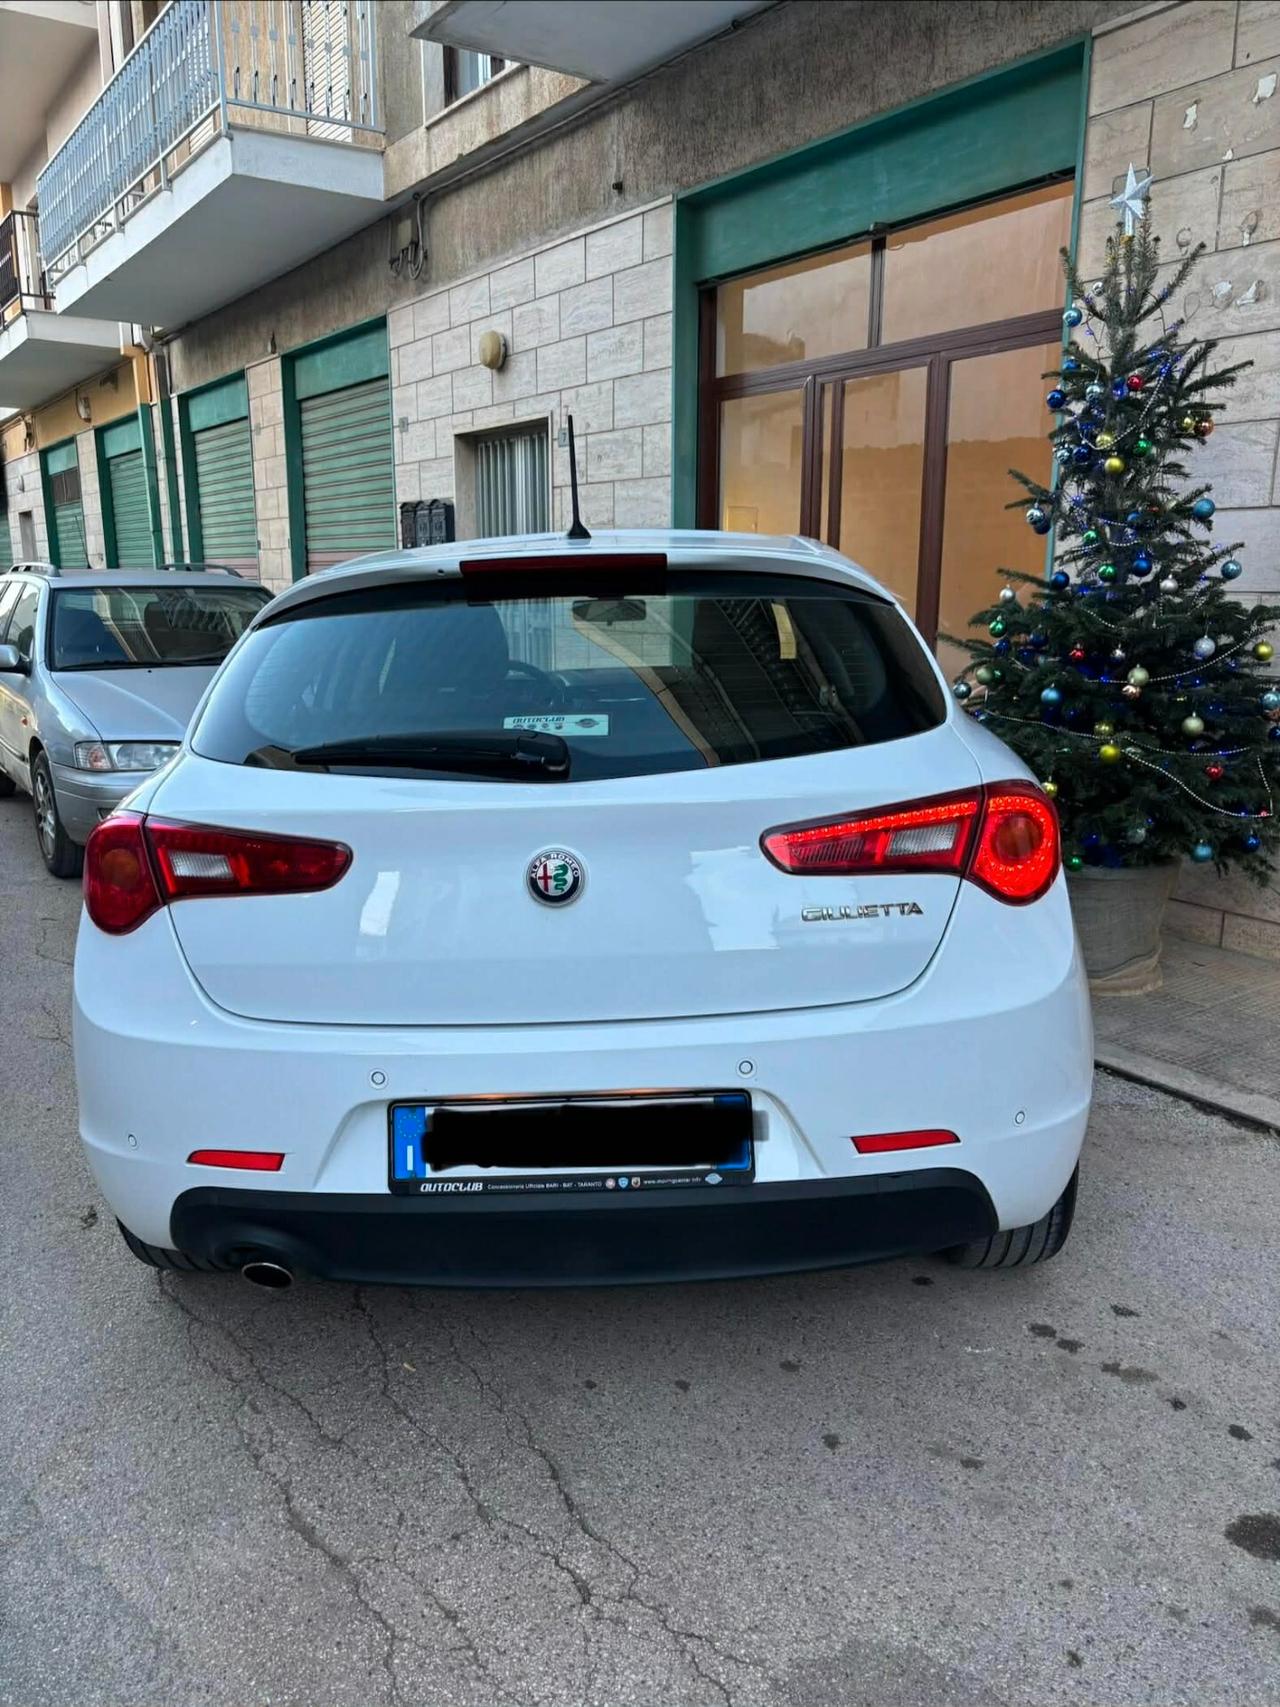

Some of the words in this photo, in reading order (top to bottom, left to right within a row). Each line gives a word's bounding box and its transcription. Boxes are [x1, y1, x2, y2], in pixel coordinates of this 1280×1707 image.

[530, 855, 547, 878] ALFA
[550, 853, 580, 878] ROMEO
[801, 902, 924, 922] GIULIETTA
[406, 1145, 414, 1171] I
[420, 1182, 483, 1192] AUTOCLUB
